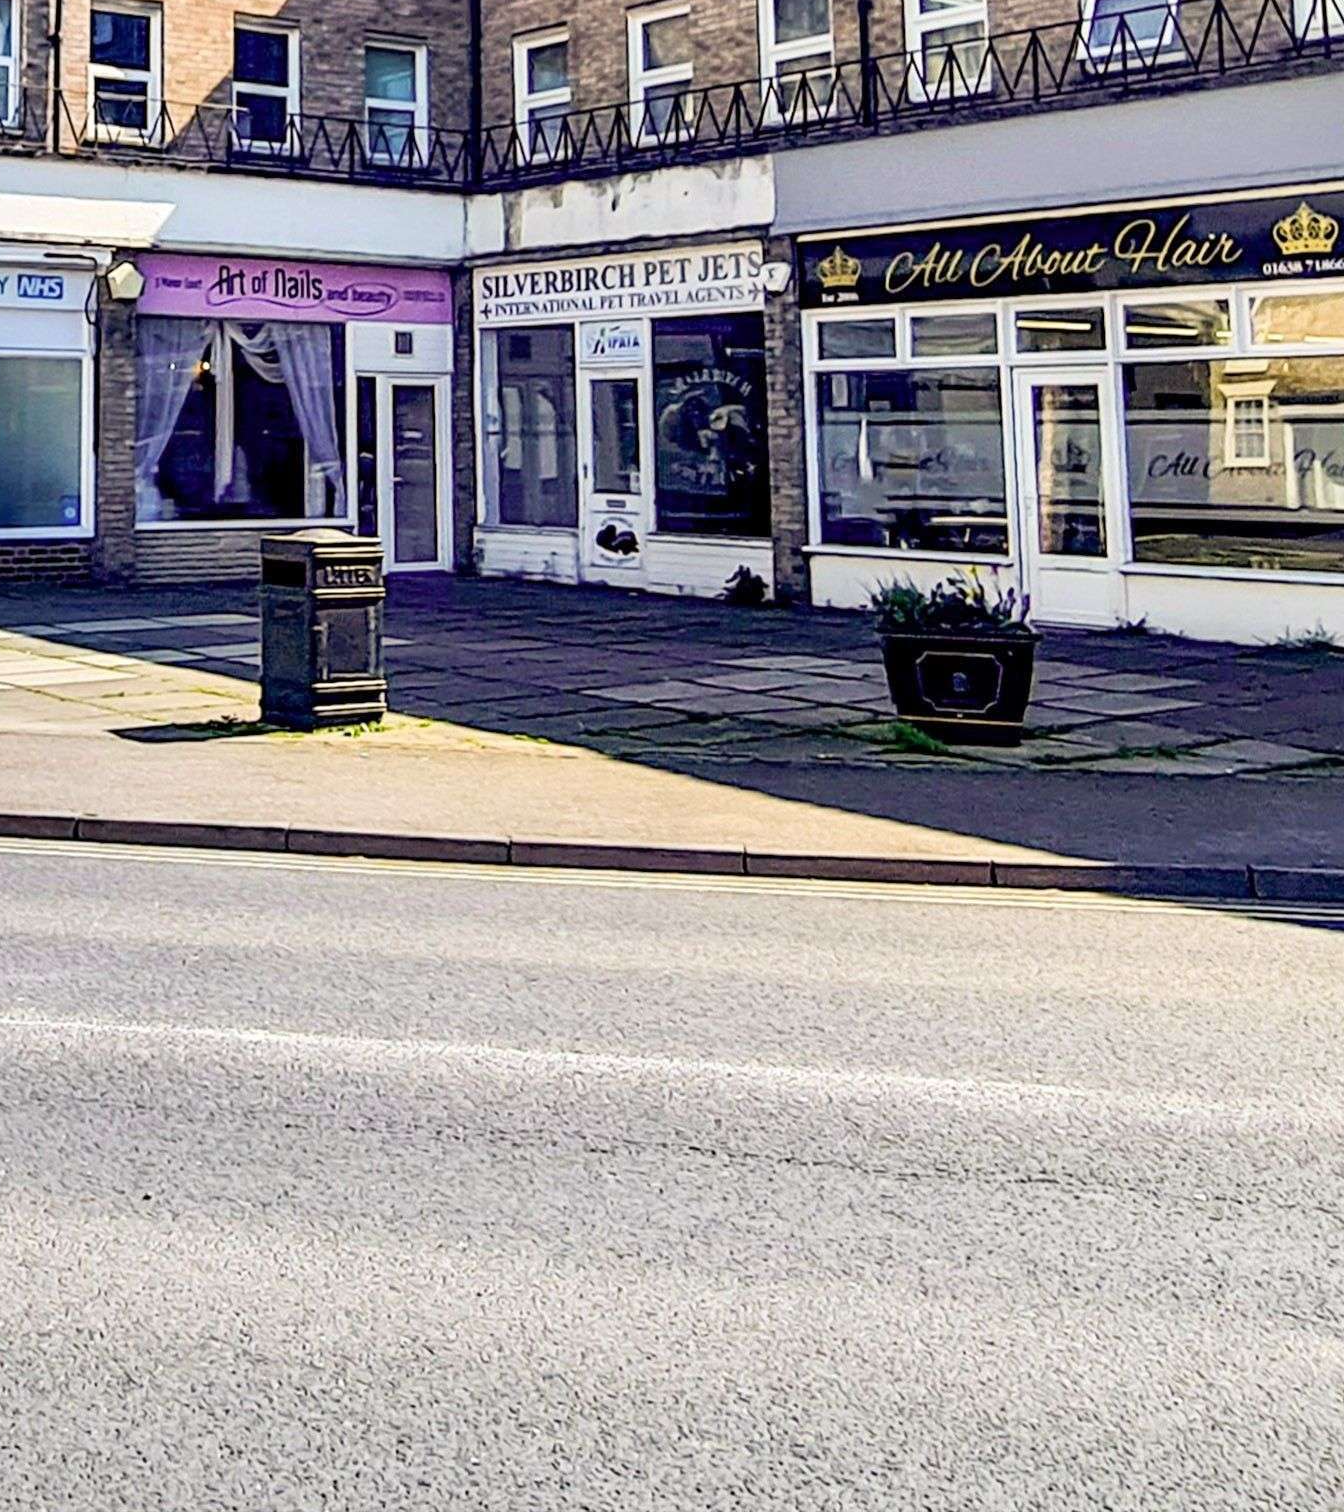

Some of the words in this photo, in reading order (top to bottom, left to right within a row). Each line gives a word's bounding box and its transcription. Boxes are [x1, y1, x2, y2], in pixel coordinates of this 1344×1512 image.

[885, 241, 963, 294] All
[969, 232, 1108, 287] About
[1114, 213, 1243, 274] Hair
[19, 274, 63, 299] NHS
[208, 264, 246, 296] Art
[252, 270, 269, 294] of
[482, 263, 635, 300] SILVERBIRCH
[643, 257, 691, 287] PET
[698, 251, 762, 282] JETS
[494, 296, 598, 318] INTERNATIONAL
[600, 294, 624, 310] PET
[629, 290, 684, 308] TRAVEL
[684, 285, 746, 304] AGENTS
